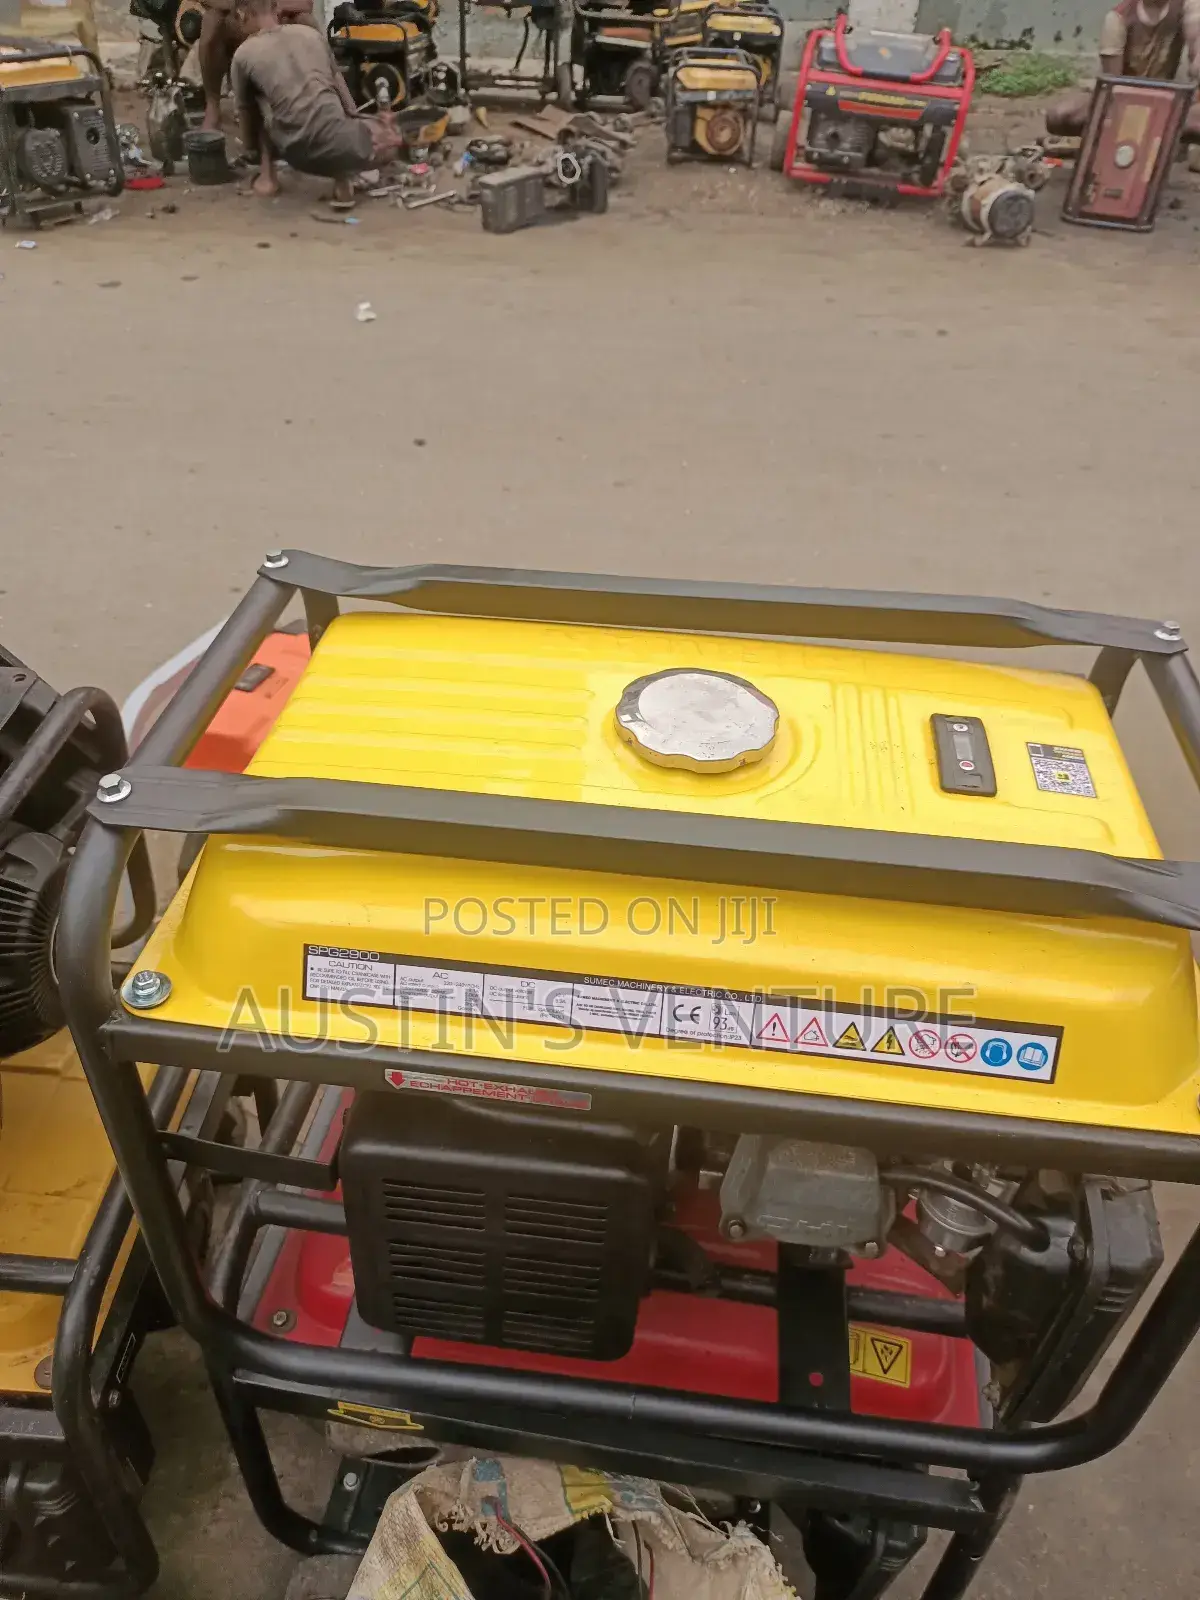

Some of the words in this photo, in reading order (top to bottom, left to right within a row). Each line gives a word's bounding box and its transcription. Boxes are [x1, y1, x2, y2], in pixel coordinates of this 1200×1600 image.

[308, 945, 380, 961] SPG2900
[328, 960, 373, 971] CAUTION
[432, 971, 449, 980] AC
[520, 980, 536, 988] DC
[584, 976, 615, 987] SUMEC
[617, 980, 668, 992] MACHINERY
[679, 987, 722, 998] ELECTRIC
[672, 1003, 702, 1025] CE
[712, 1016, 728, 1031] 93
[665, 1027, 688, 1036] Degree
